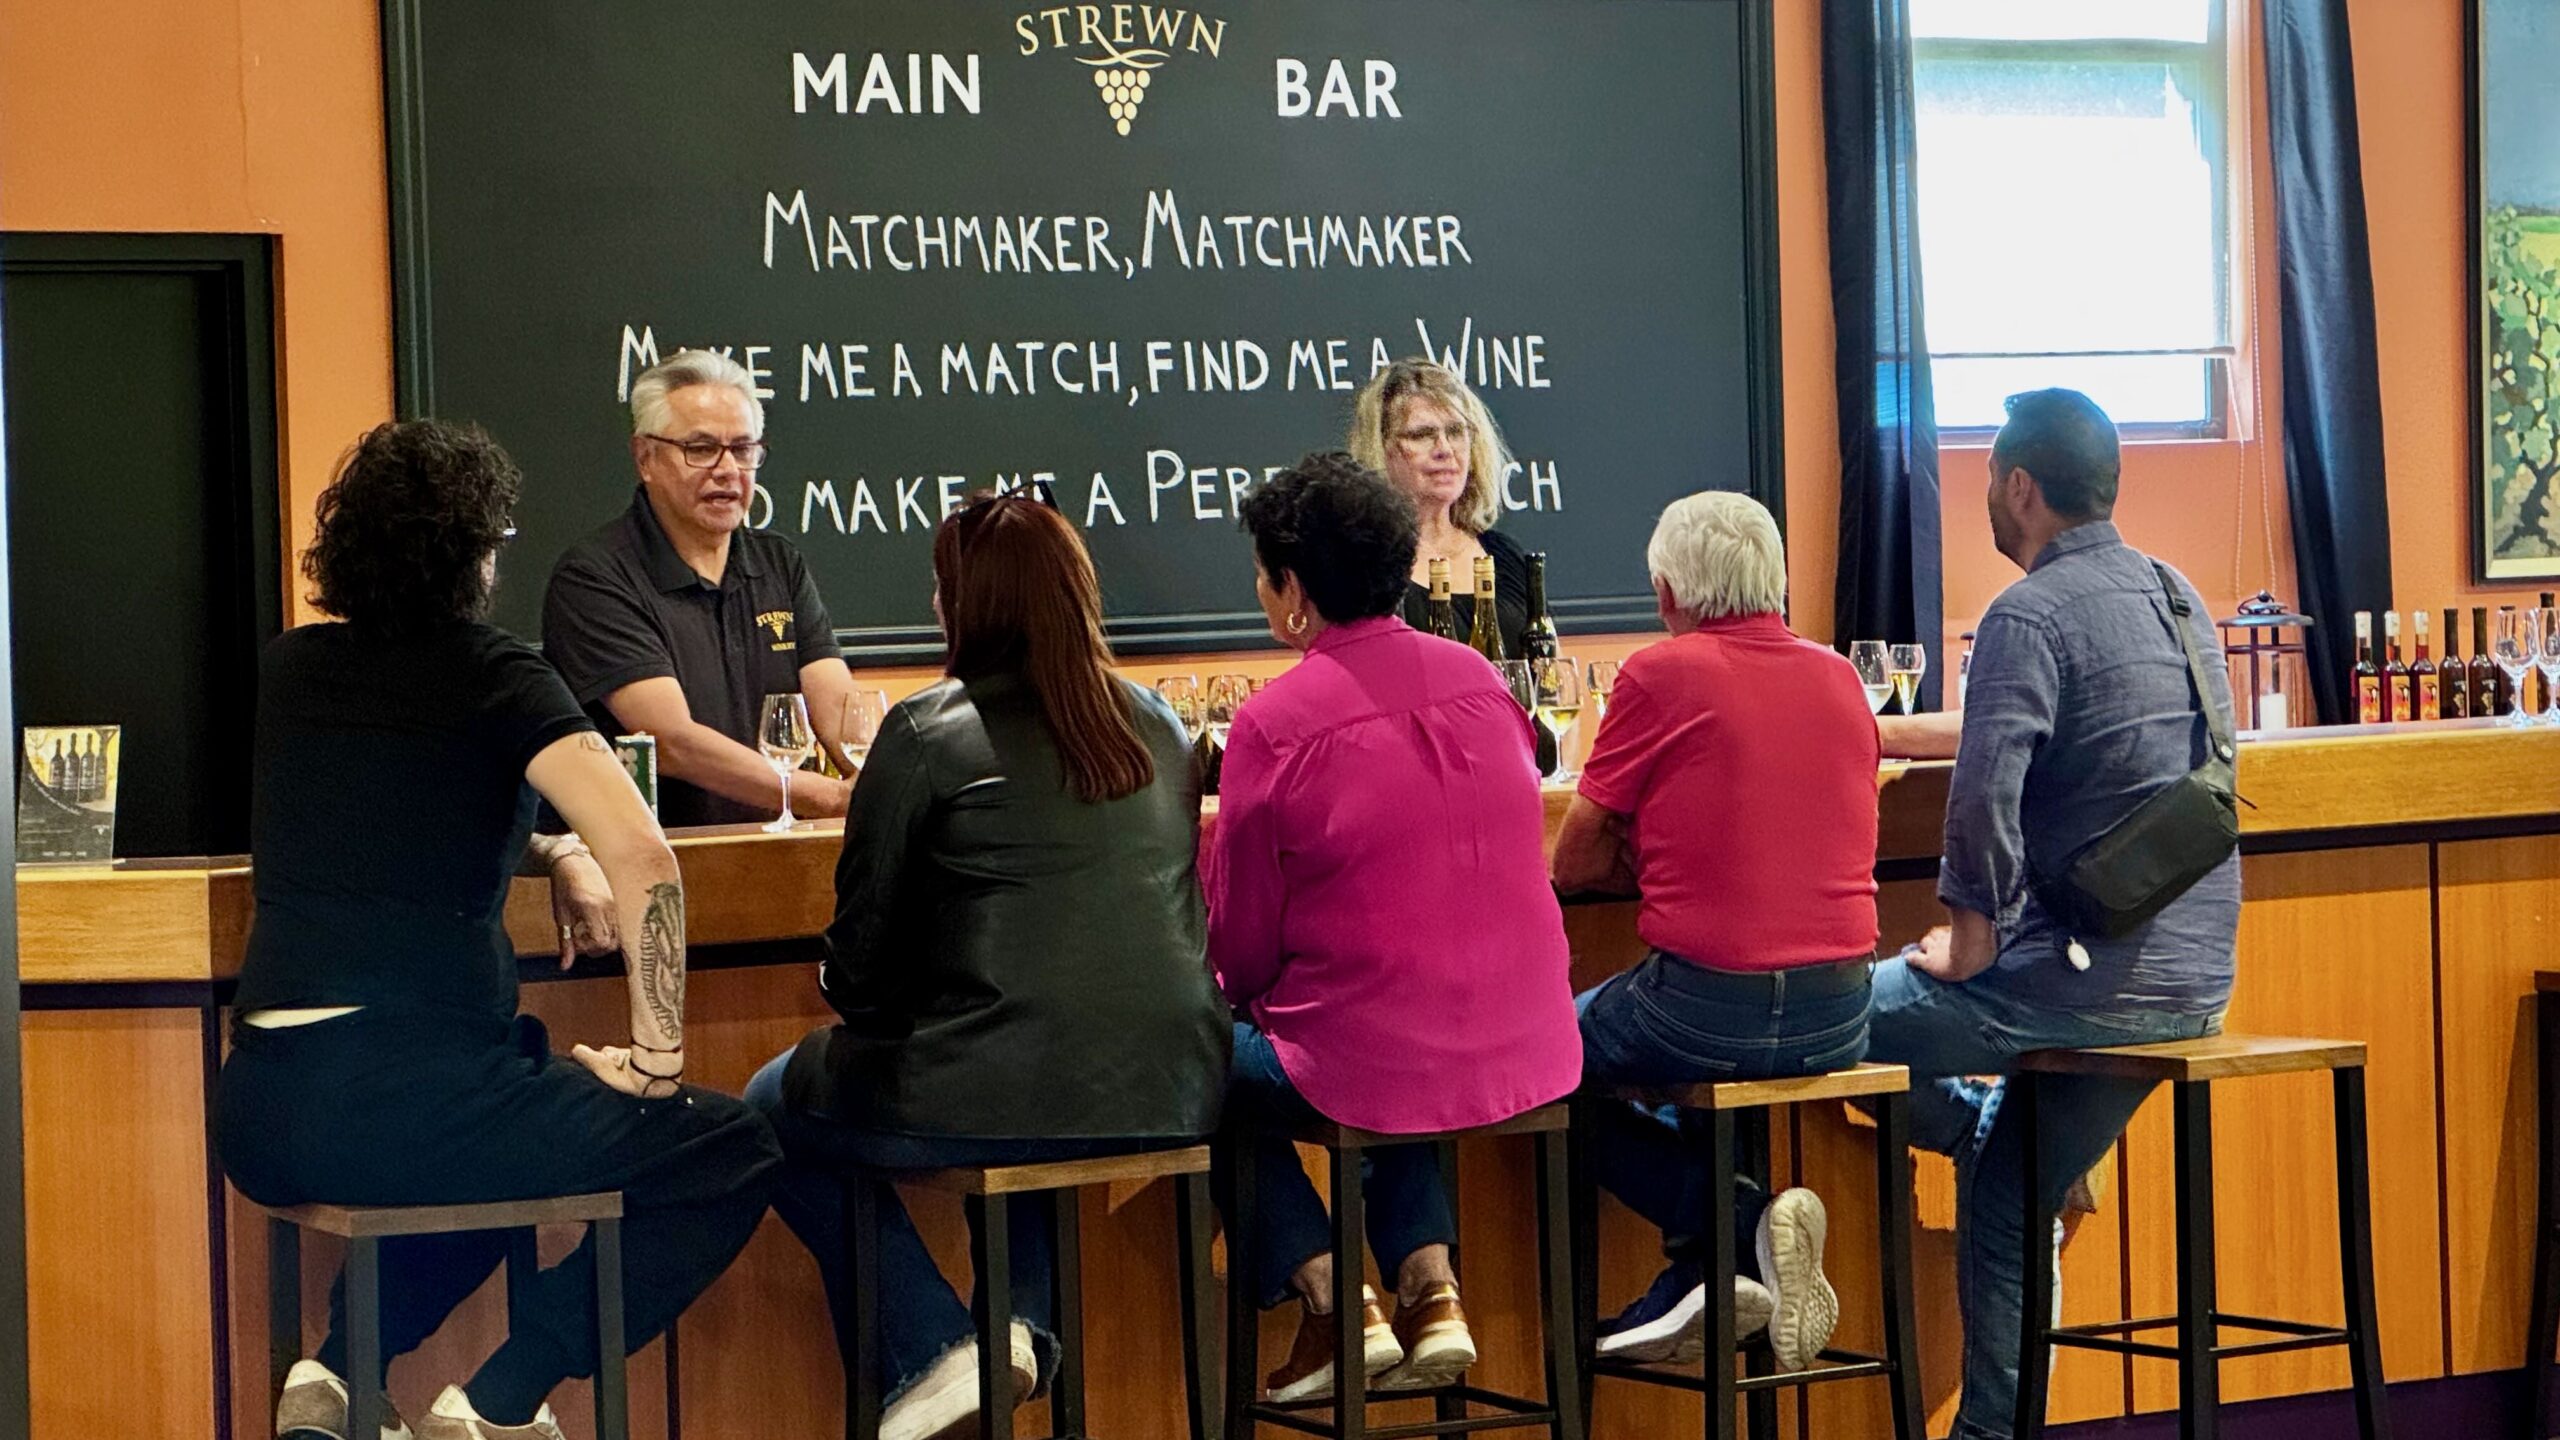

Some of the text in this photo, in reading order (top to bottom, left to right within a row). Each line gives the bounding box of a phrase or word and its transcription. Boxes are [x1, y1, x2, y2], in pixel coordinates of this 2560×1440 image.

[1015, 4, 1228, 69] STREWN
[793, 53, 1403, 118] MAIN BAR
[763, 189, 1472, 280] MATCHMAKER, MATCHMAKER
[618, 324, 776, 402] ME
[800, 342, 875, 402] ME
[893, 342, 923, 398] A
[941, 340, 1139, 407] MATCH,
[1146, 340, 1270, 393] FIND
[1287, 339, 1355, 391] ME
[1415, 316, 1551, 390] WINE
[801, 475, 966, 534] MAKE
[1085, 471, 1127, 527] A
